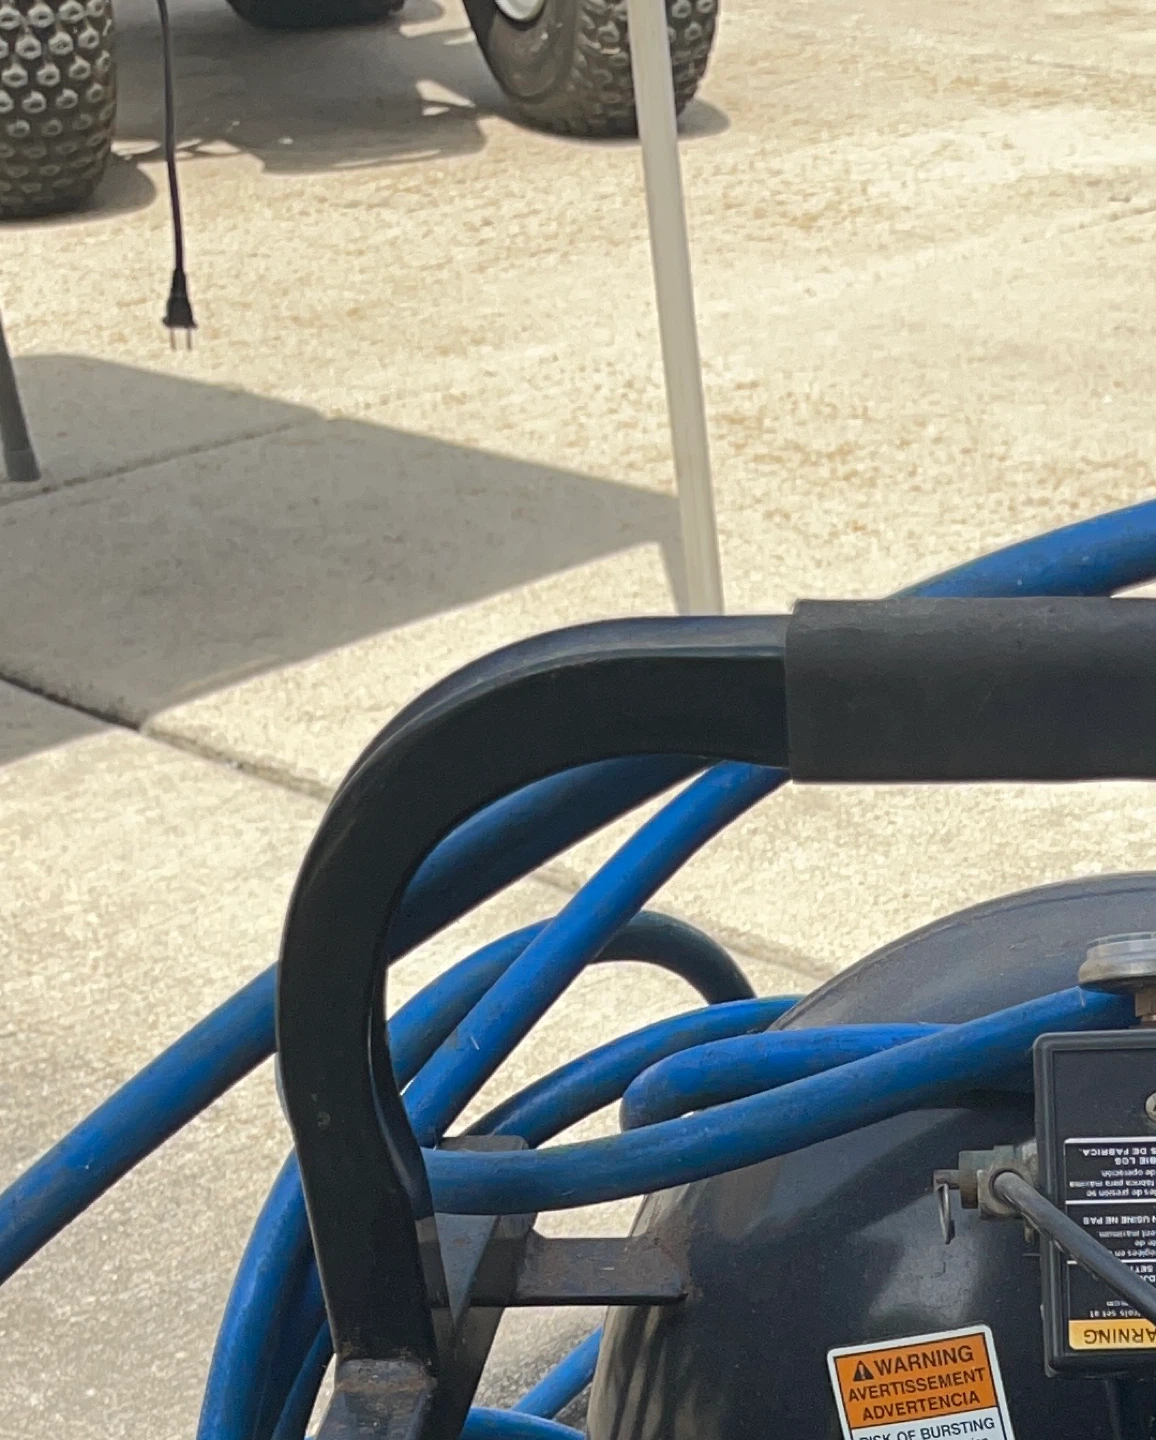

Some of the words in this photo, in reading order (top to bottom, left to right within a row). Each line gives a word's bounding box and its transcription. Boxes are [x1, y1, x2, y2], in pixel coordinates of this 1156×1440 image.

[874, 1345, 974, 1376] WARNING
[849, 1367, 985, 1402] AVERTISSEMENT
[863, 1391, 980, 1421] ADVERTENCIA
[920, 1417, 995, 1440] BURSTING
